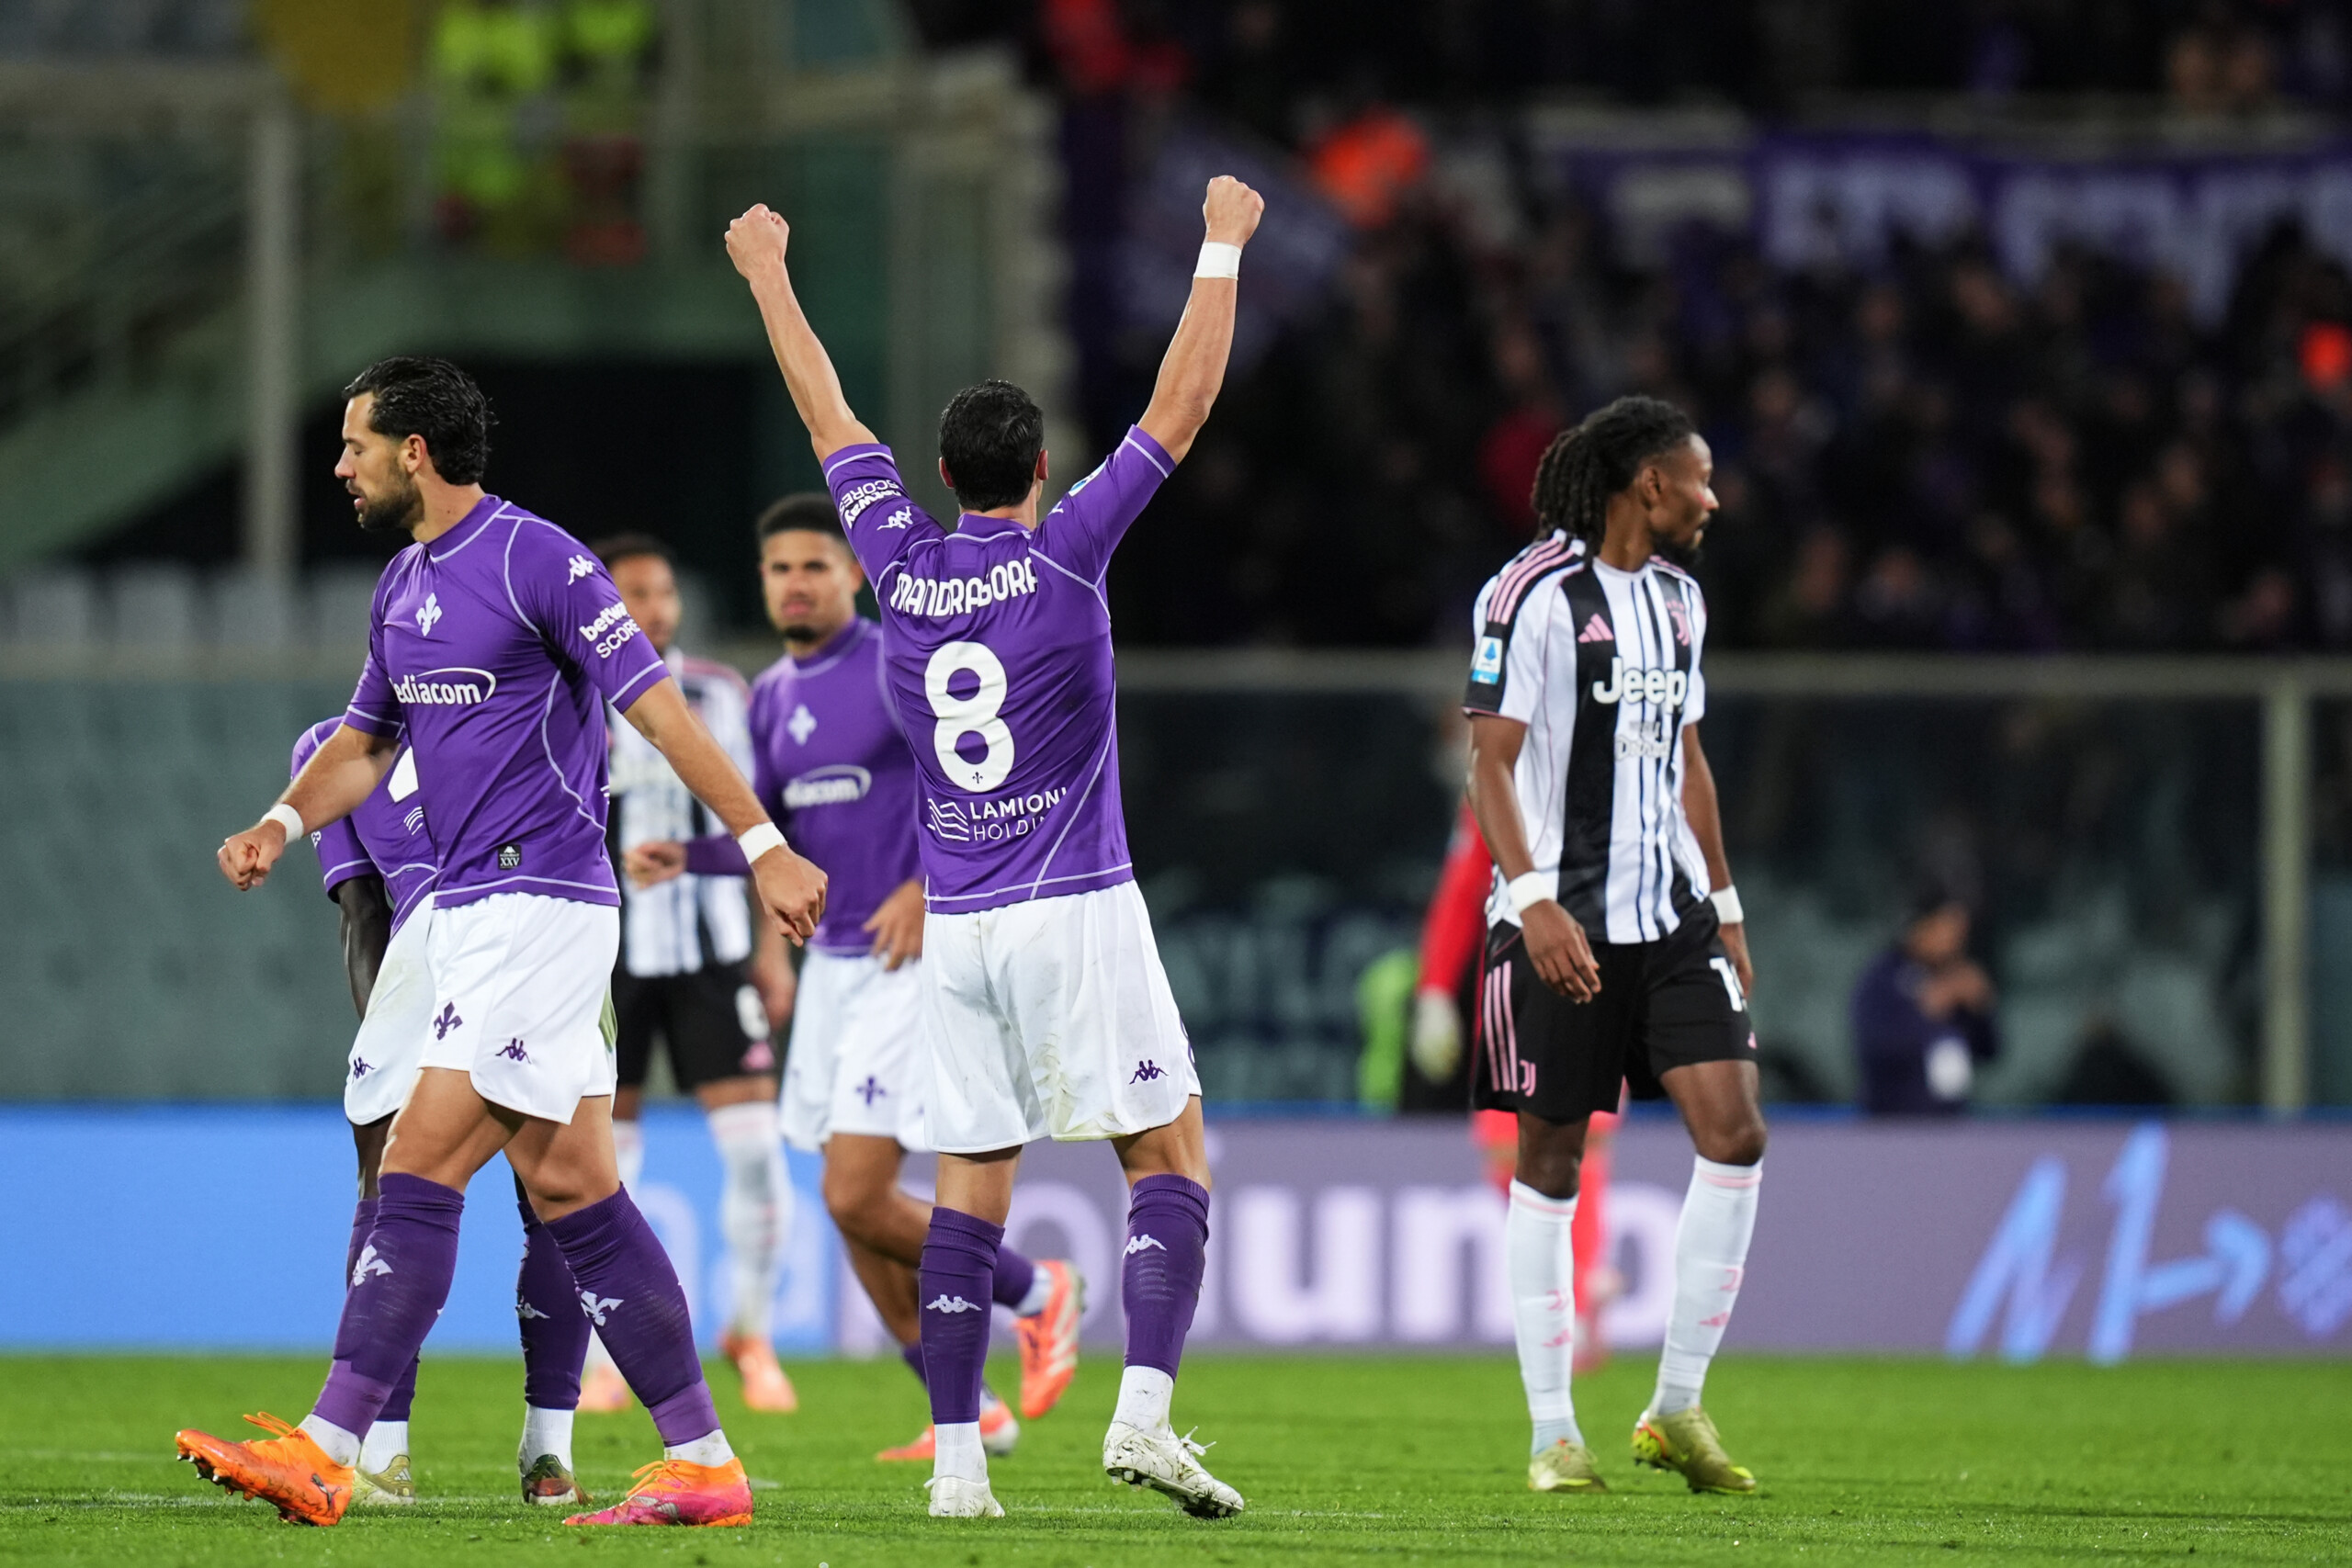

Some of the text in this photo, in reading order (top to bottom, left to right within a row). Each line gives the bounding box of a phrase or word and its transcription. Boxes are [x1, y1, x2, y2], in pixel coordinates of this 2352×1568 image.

[595, 618, 640, 659] SCORE
[389, 673, 482, 705] ediacom
[1592, 656, 1687, 715] Jeep
[924, 640, 1015, 793] 8
[1709, 956, 1747, 1011] 1
